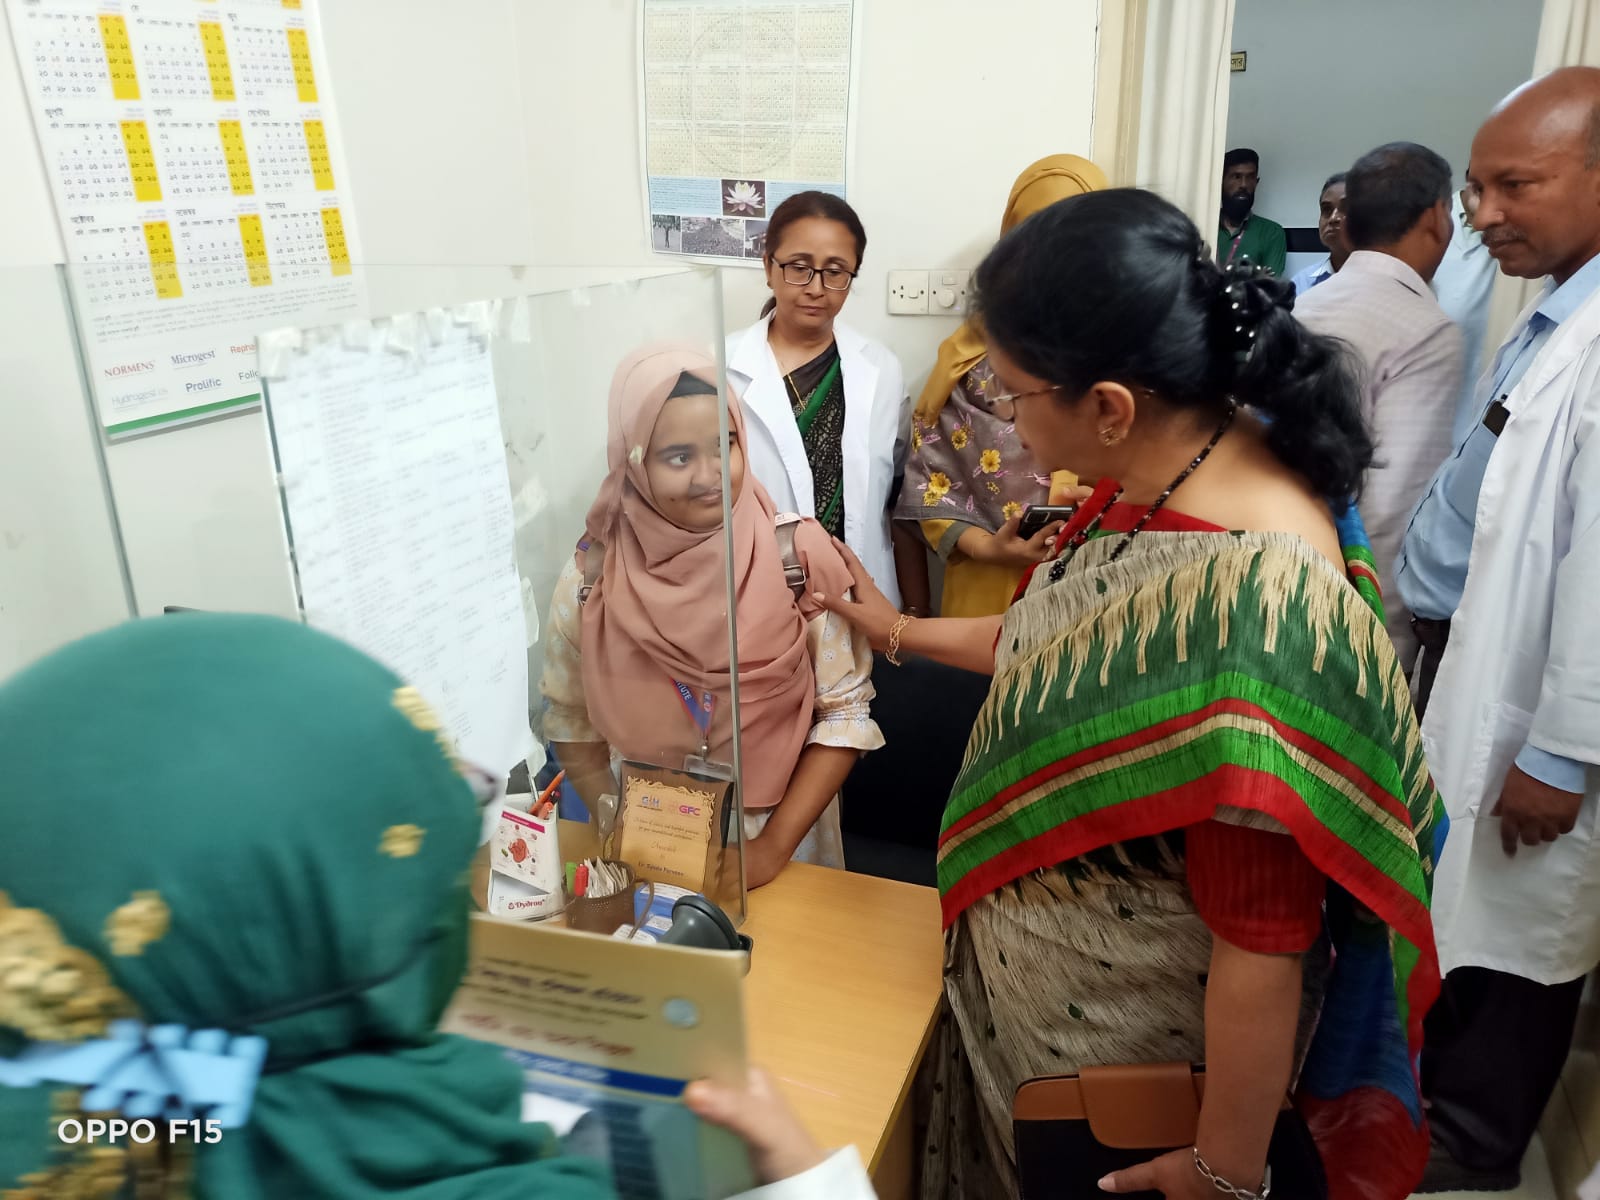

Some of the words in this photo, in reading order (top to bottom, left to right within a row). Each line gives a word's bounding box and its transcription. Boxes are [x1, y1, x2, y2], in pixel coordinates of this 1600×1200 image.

[171, 350, 216, 365] Microgest
[104, 360, 154, 377] NORMENS
[186, 377, 222, 392] Prolific
[678, 804, 701, 817] GFC
